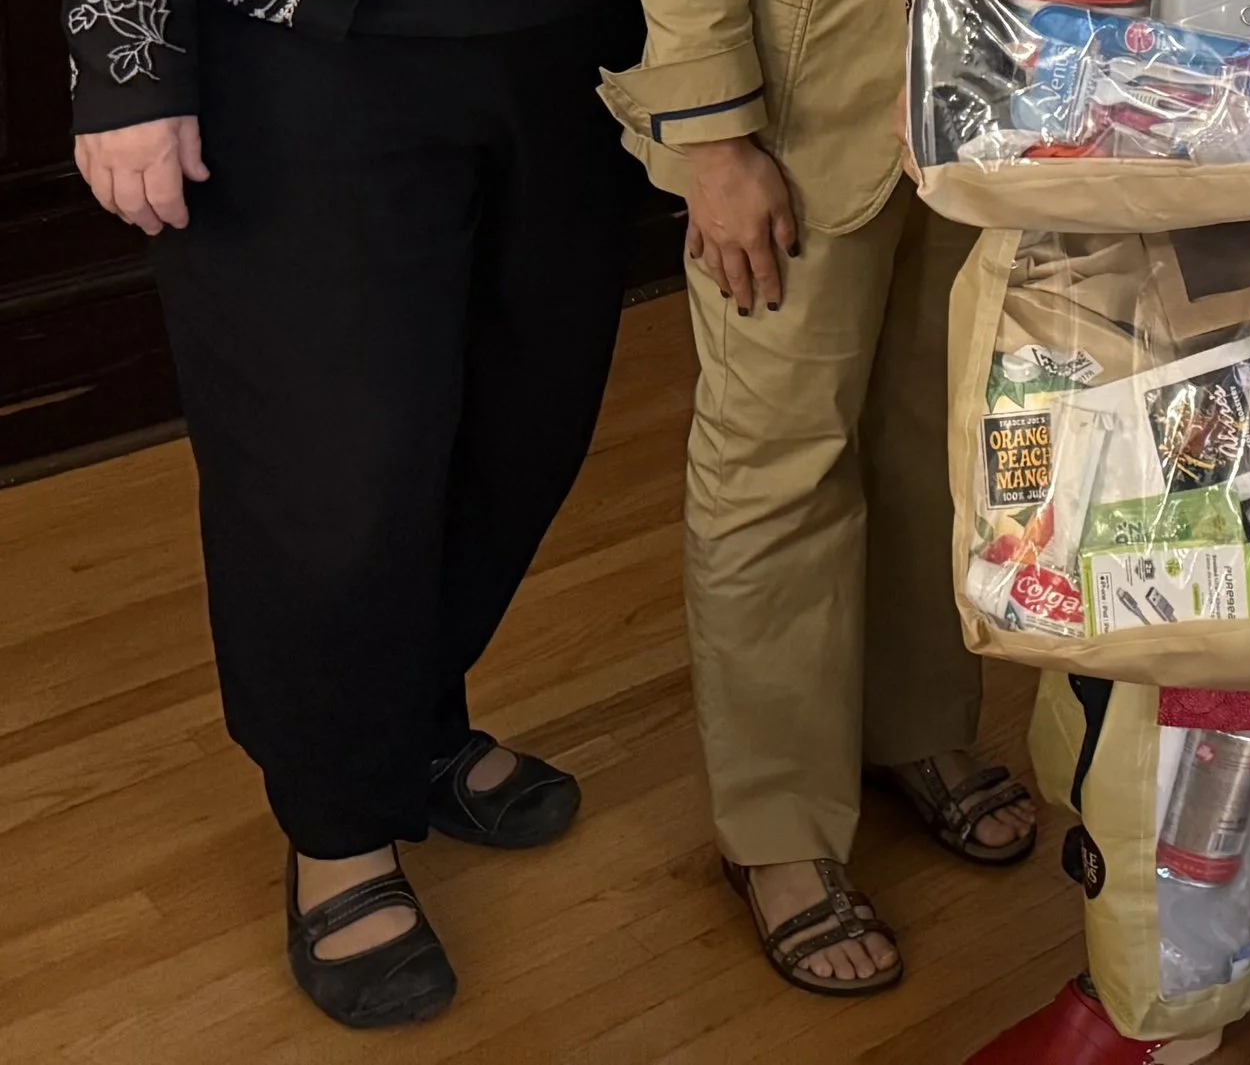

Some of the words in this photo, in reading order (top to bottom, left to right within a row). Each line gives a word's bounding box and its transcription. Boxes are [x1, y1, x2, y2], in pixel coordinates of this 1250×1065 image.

[997, 447, 1052, 470] PEACH
[996, 466, 1053, 490] MANG
[1003, 491, 1026, 502] 100%
